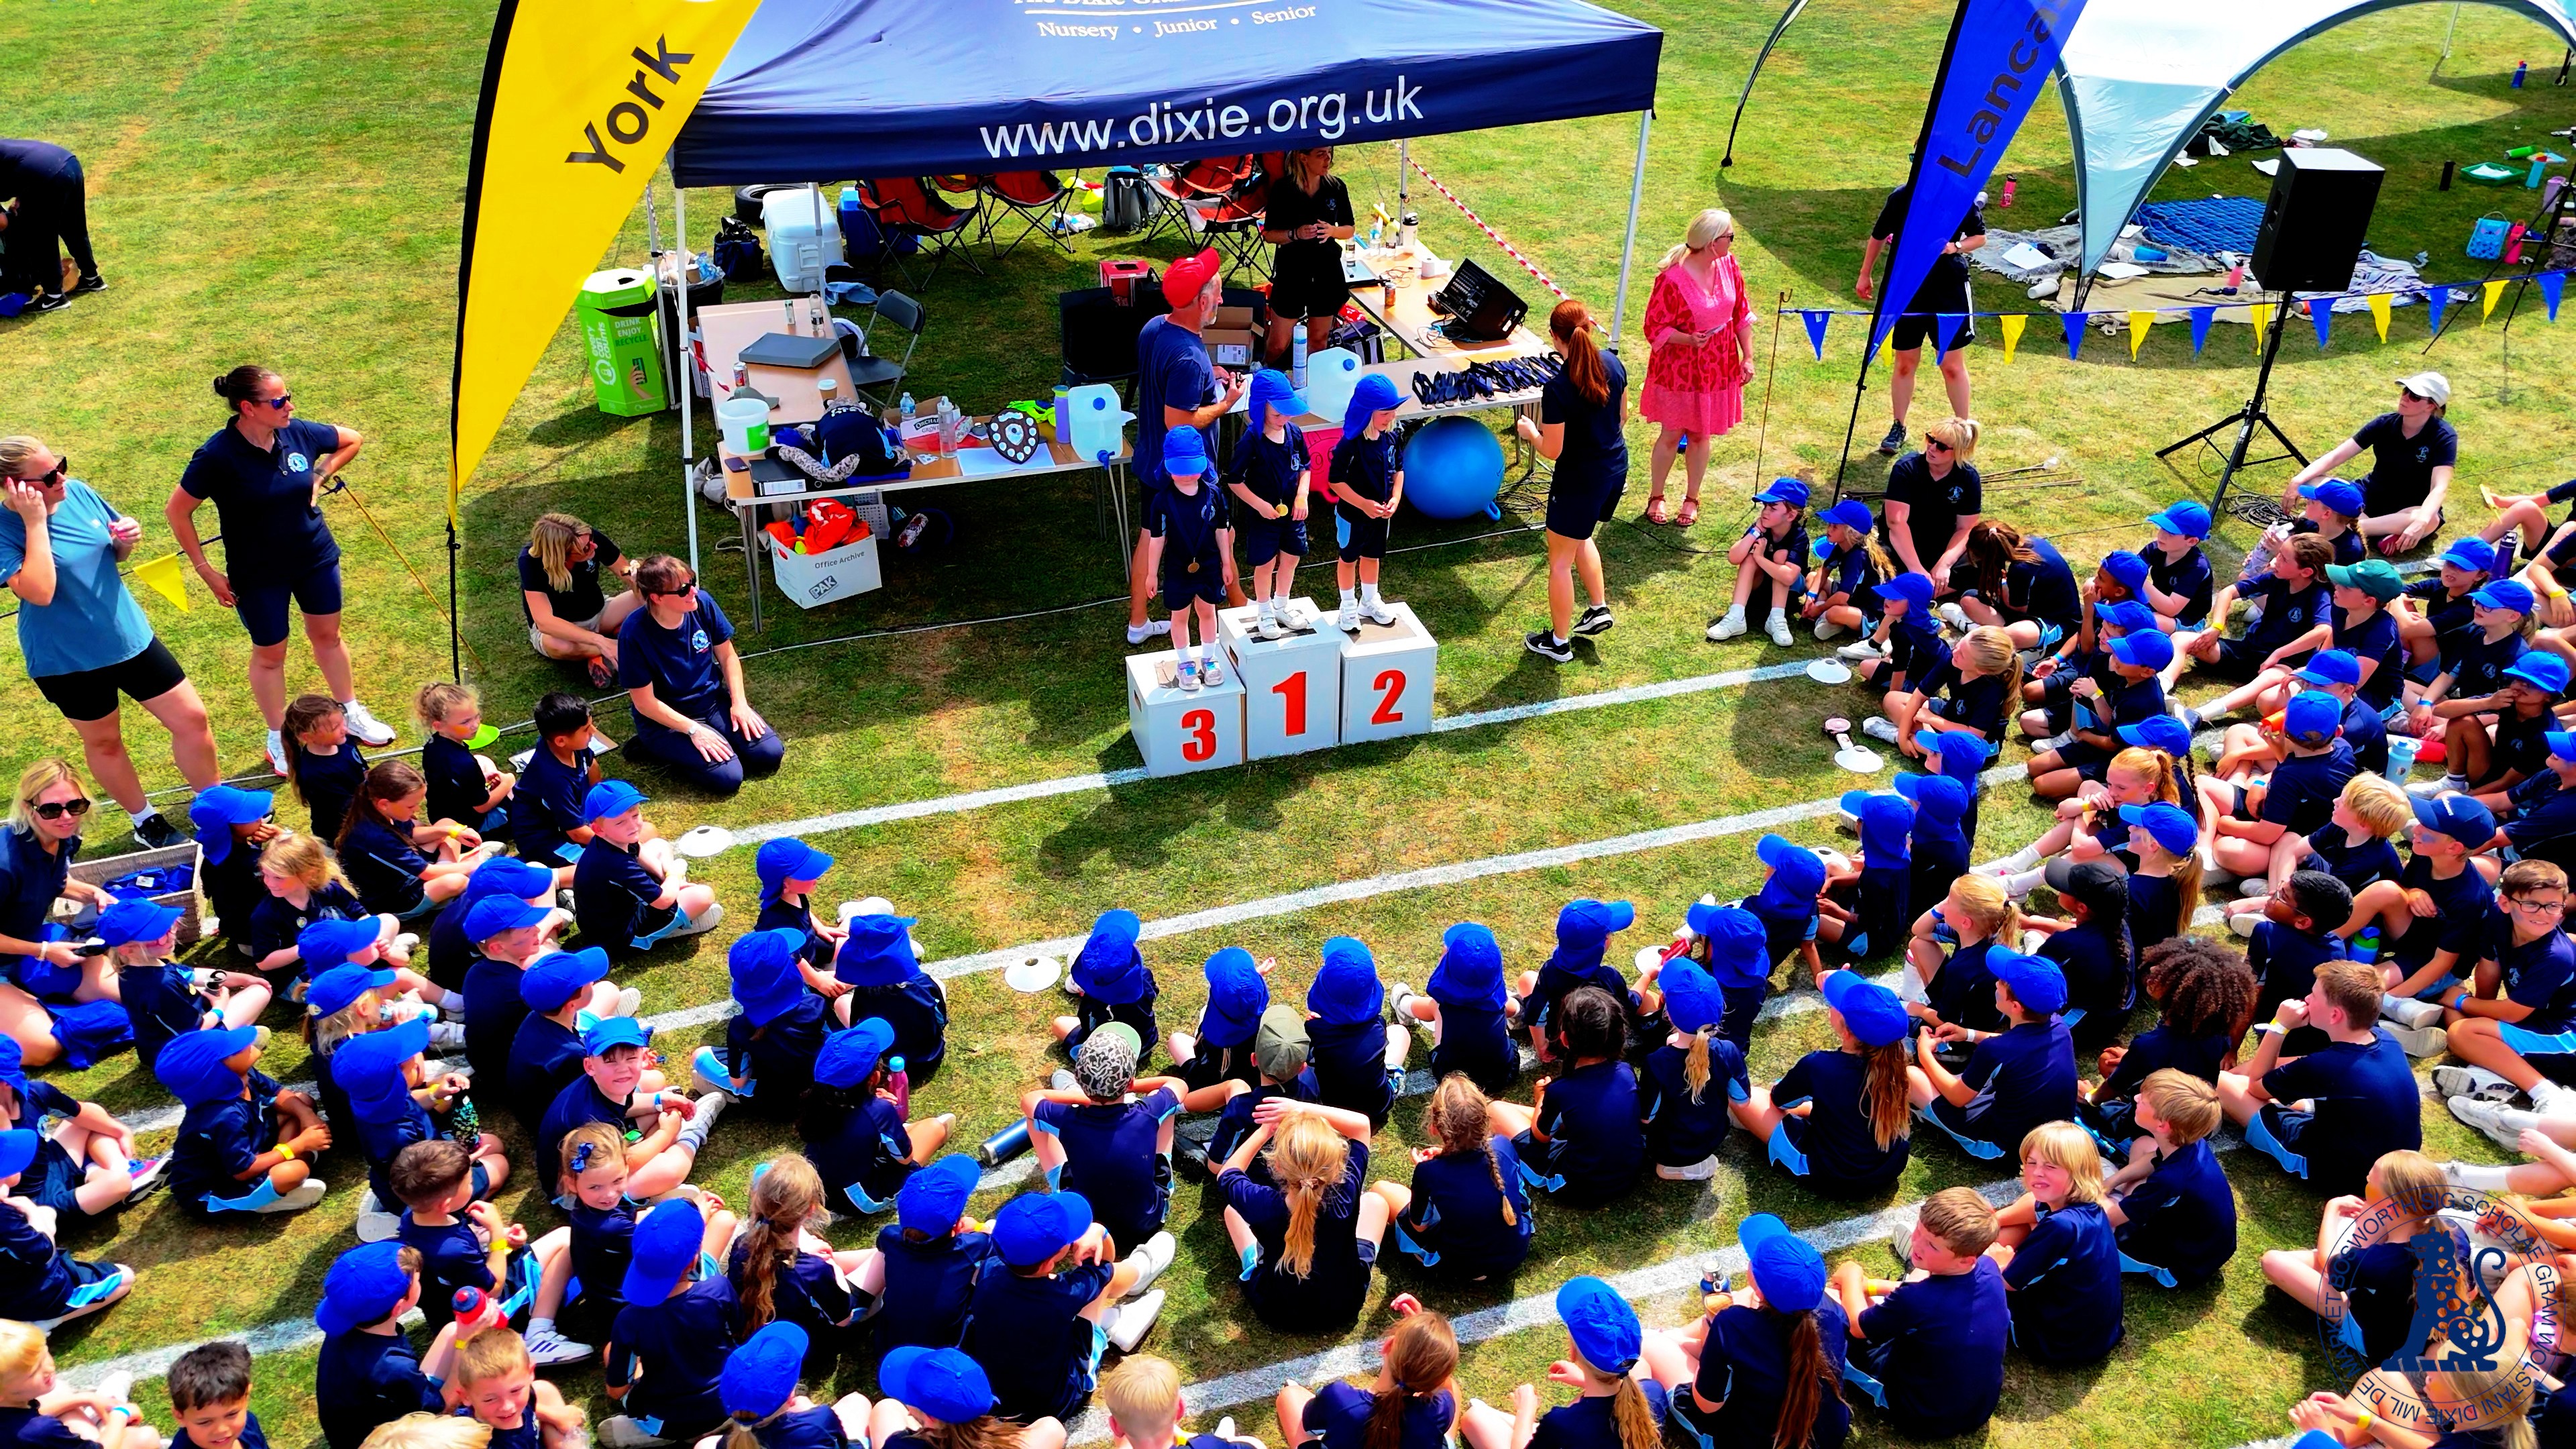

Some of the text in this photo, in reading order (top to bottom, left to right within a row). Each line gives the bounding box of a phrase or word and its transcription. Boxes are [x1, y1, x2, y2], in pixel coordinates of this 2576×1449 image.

[1037, 7, 1316, 40] Nursery Junior Senior
[565, 33, 695, 174] York
[1937, 0, 2070, 178] Lanca
[980, 74, 1423, 159] www.dixie.org.uk
[586, 325, 599, 357] every
[596, 337, 604, 358] can
[598, 321, 612, 359] counts
[814, 551, 865, 569] Office Archive
[809, 576, 836, 598] PAK
[1272, 671, 1307, 737] 1
[1371, 669, 1407, 725] 2
[1181, 708, 1217, 763] 3
